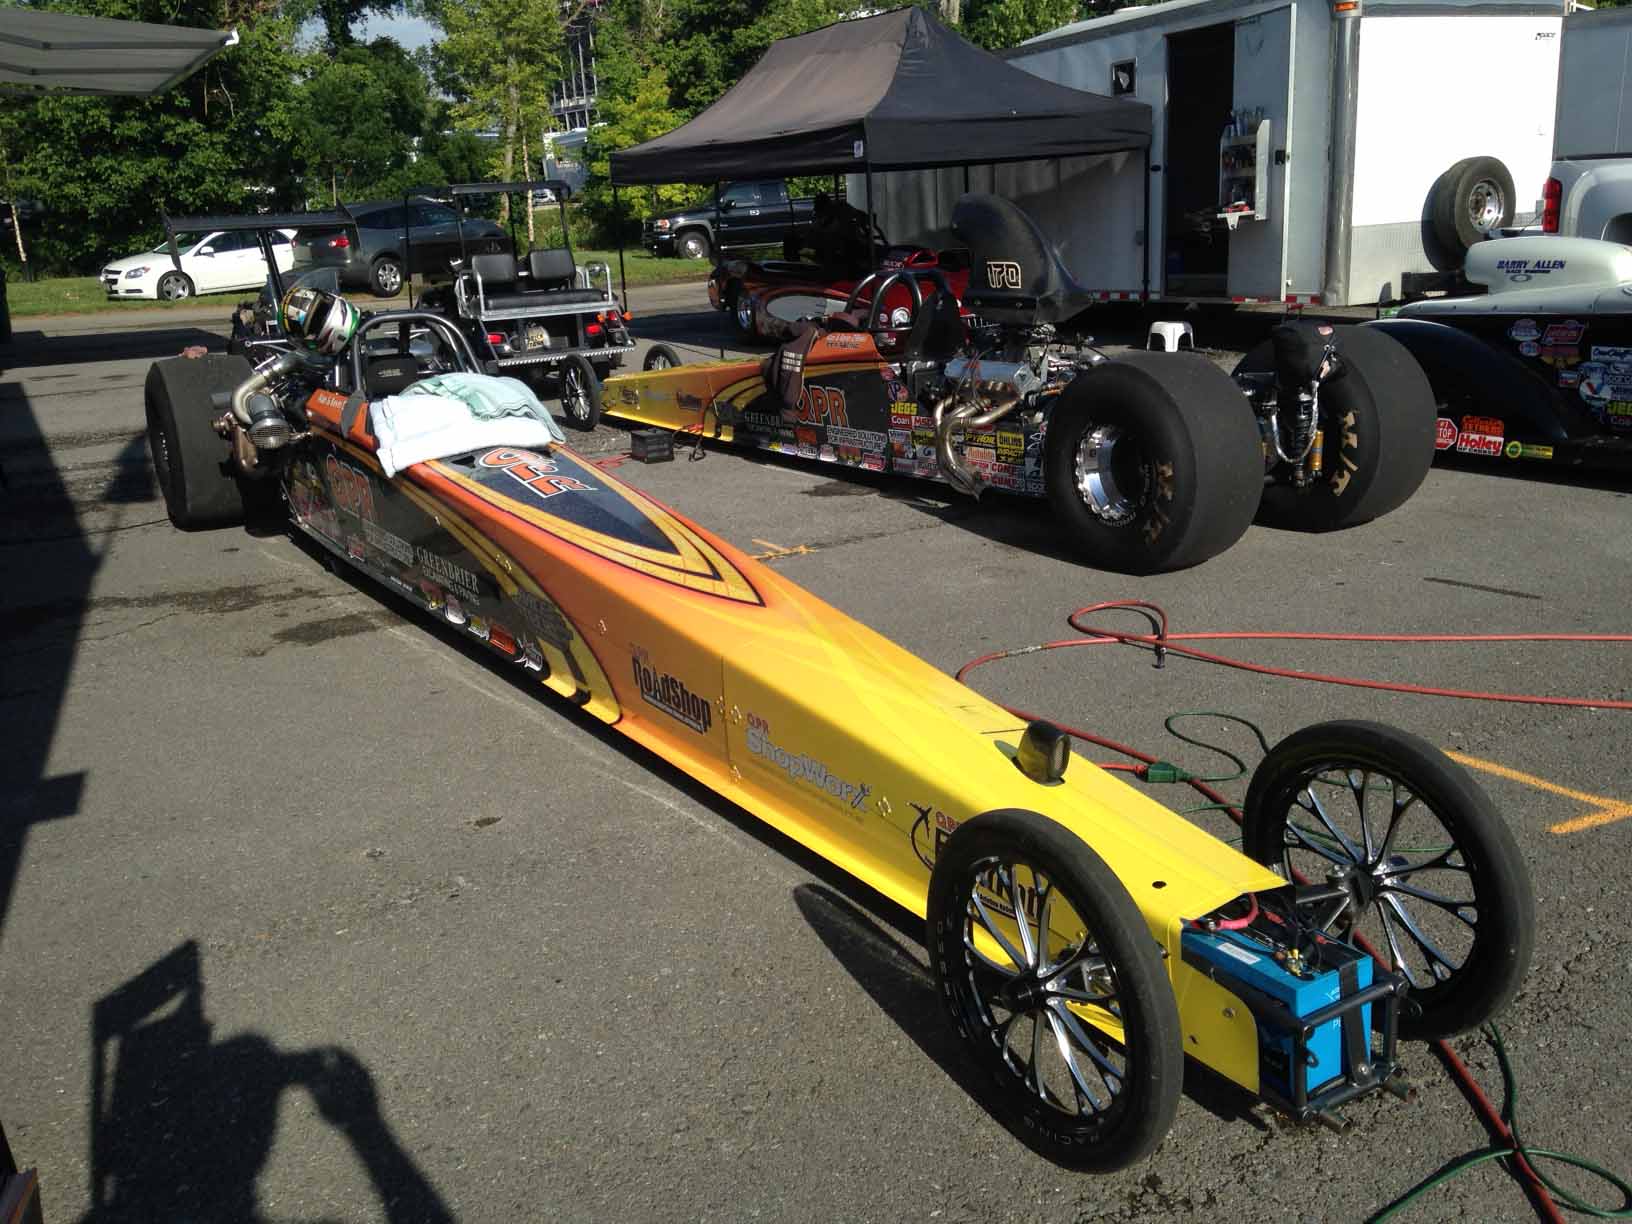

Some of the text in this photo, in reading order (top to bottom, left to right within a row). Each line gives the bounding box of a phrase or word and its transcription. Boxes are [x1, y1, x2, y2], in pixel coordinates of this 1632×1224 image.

[1497, 260, 1566, 269] BARRY ALLEN
[1460, 434, 1502, 454] Holley
